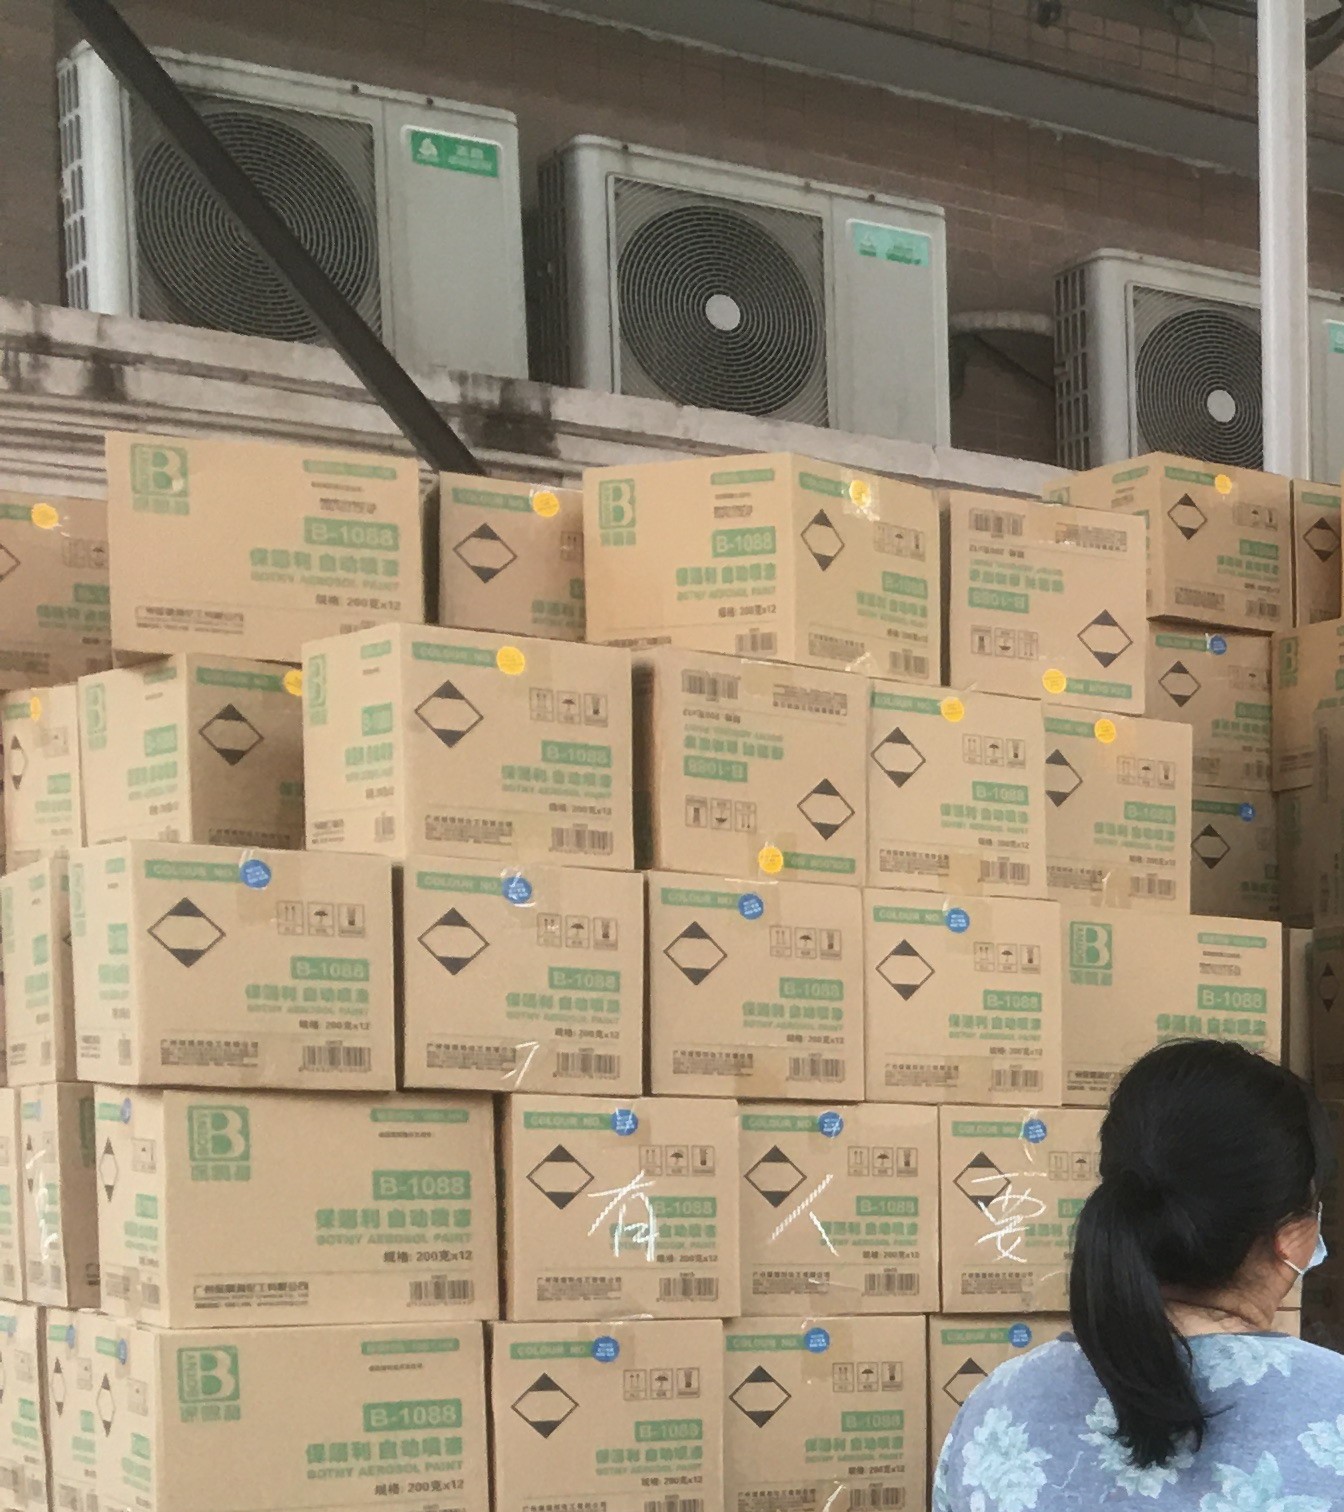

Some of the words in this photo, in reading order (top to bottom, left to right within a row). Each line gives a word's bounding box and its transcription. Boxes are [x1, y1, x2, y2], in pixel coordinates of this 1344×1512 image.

[311, 523, 394, 546] B-1088
[716, 531, 773, 552] B-1088
[1203, 989, 1263, 1006] B-1088
[380, 1174, 466, 1196] B-1088
[369, 1404, 457, 1428] B-1088
